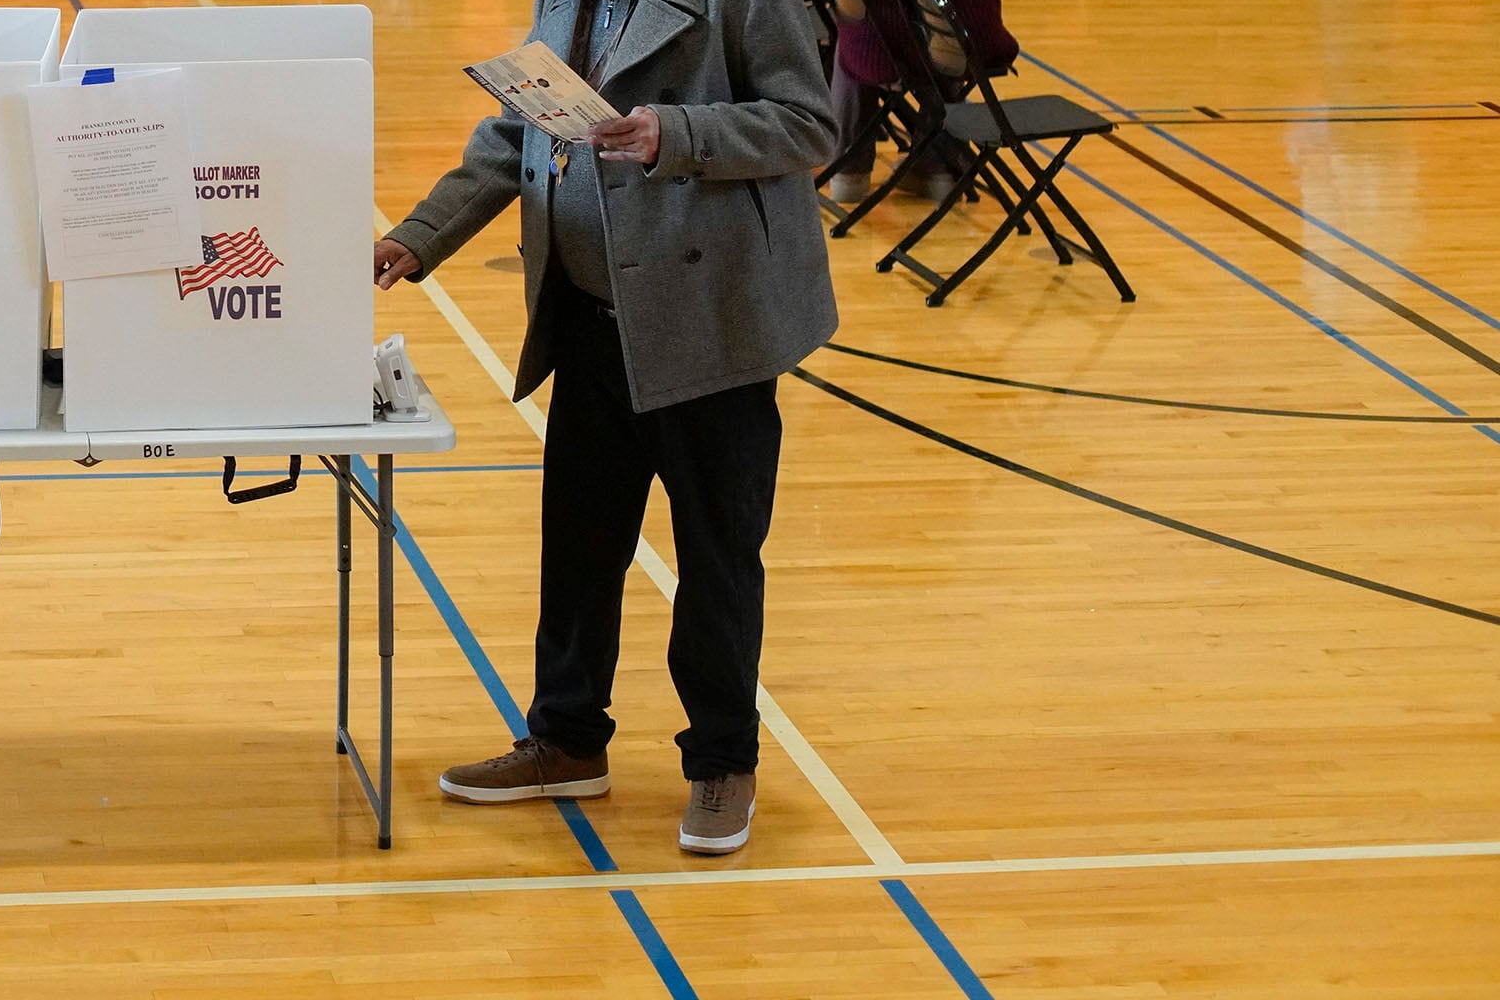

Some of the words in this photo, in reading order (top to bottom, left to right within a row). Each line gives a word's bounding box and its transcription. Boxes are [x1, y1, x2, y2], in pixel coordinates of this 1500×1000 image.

[81, 121, 112, 130] FRANKLIN
[112, 118, 137, 126] COUNTY
[56, 127, 141, 143] AUTHORITY-TO-VOTE
[143, 123, 165, 132] SLIPS
[193, 166, 220, 182] ALLOT
[222, 165, 260, 181] MARKER
[207, 285, 282, 320] VOTE
[143, 444, 176, 458] BOE
